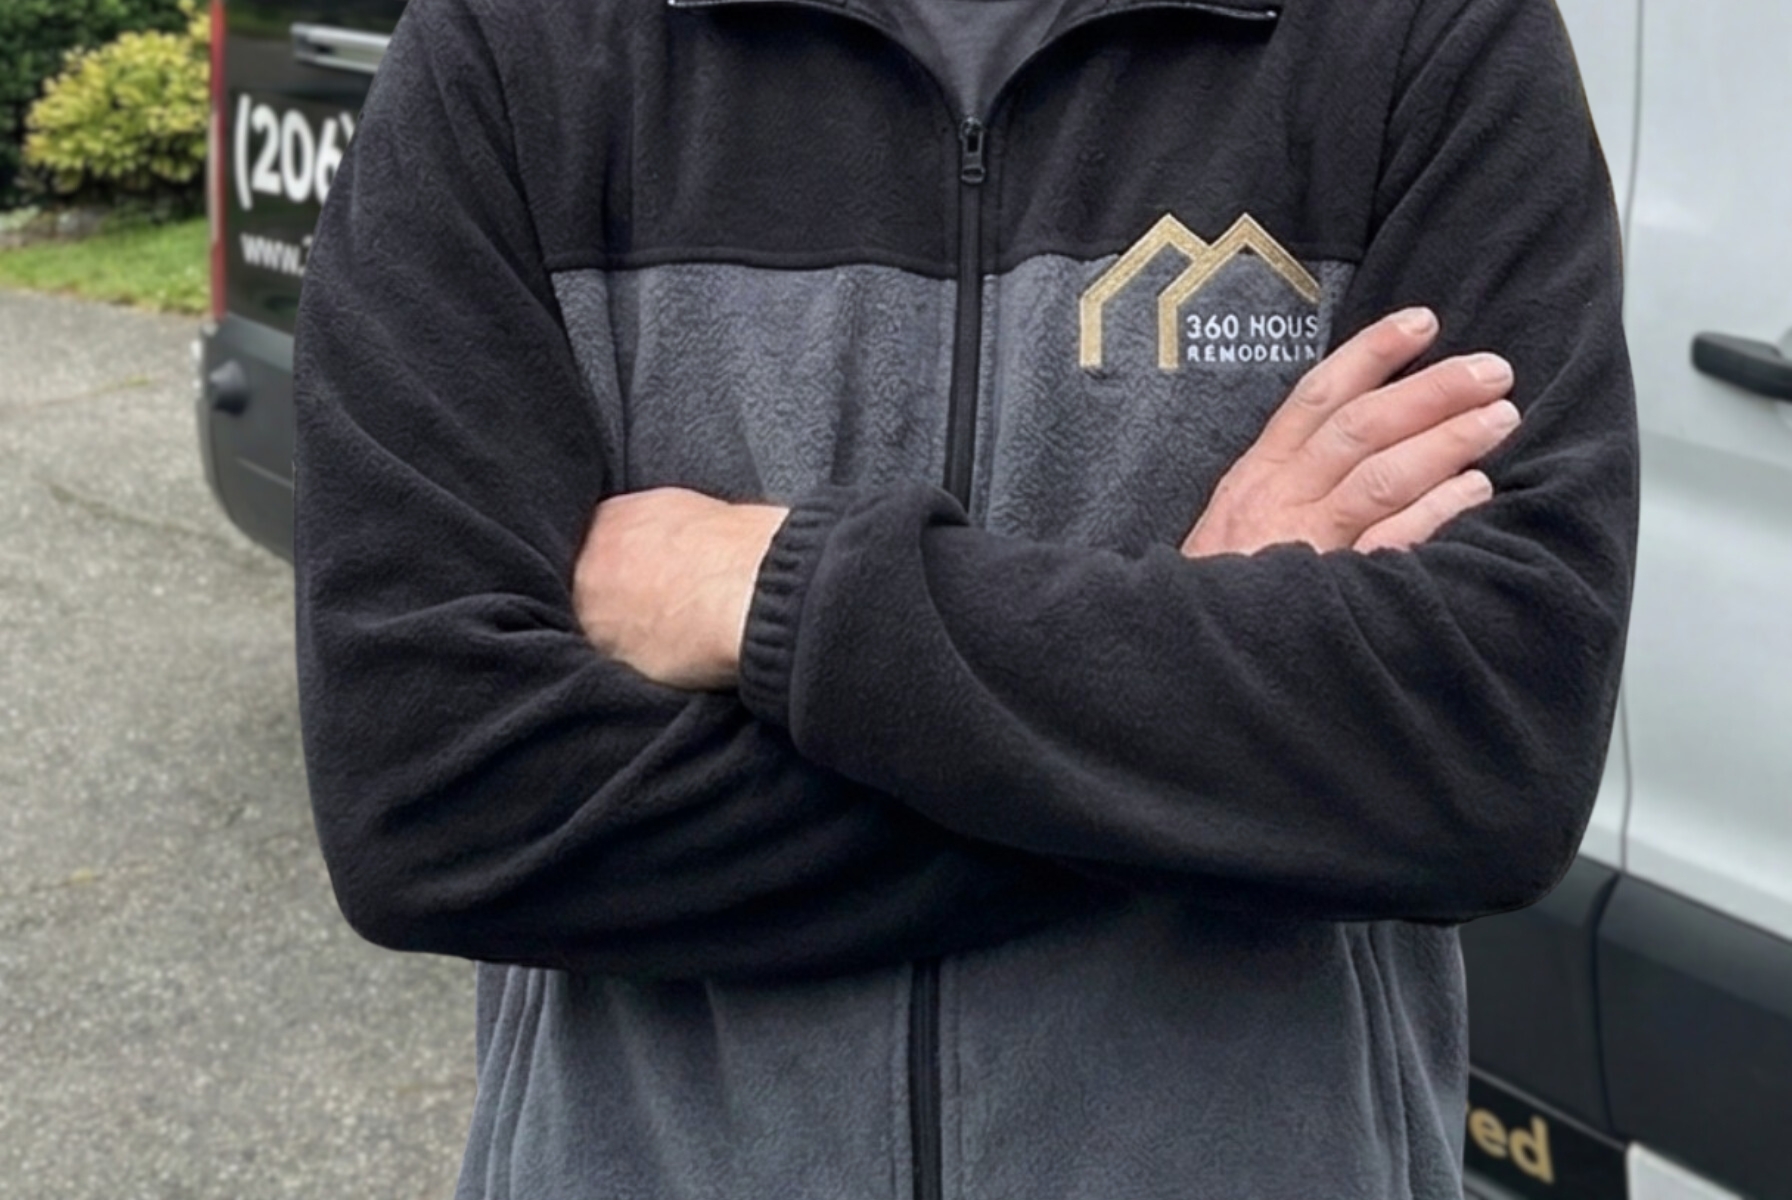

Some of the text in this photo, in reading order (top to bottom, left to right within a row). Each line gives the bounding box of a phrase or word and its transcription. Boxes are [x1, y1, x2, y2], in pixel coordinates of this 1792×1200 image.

[1186, 313, 1319, 339] 360 HOUS
[1466, 1103, 1555, 1184] ed
